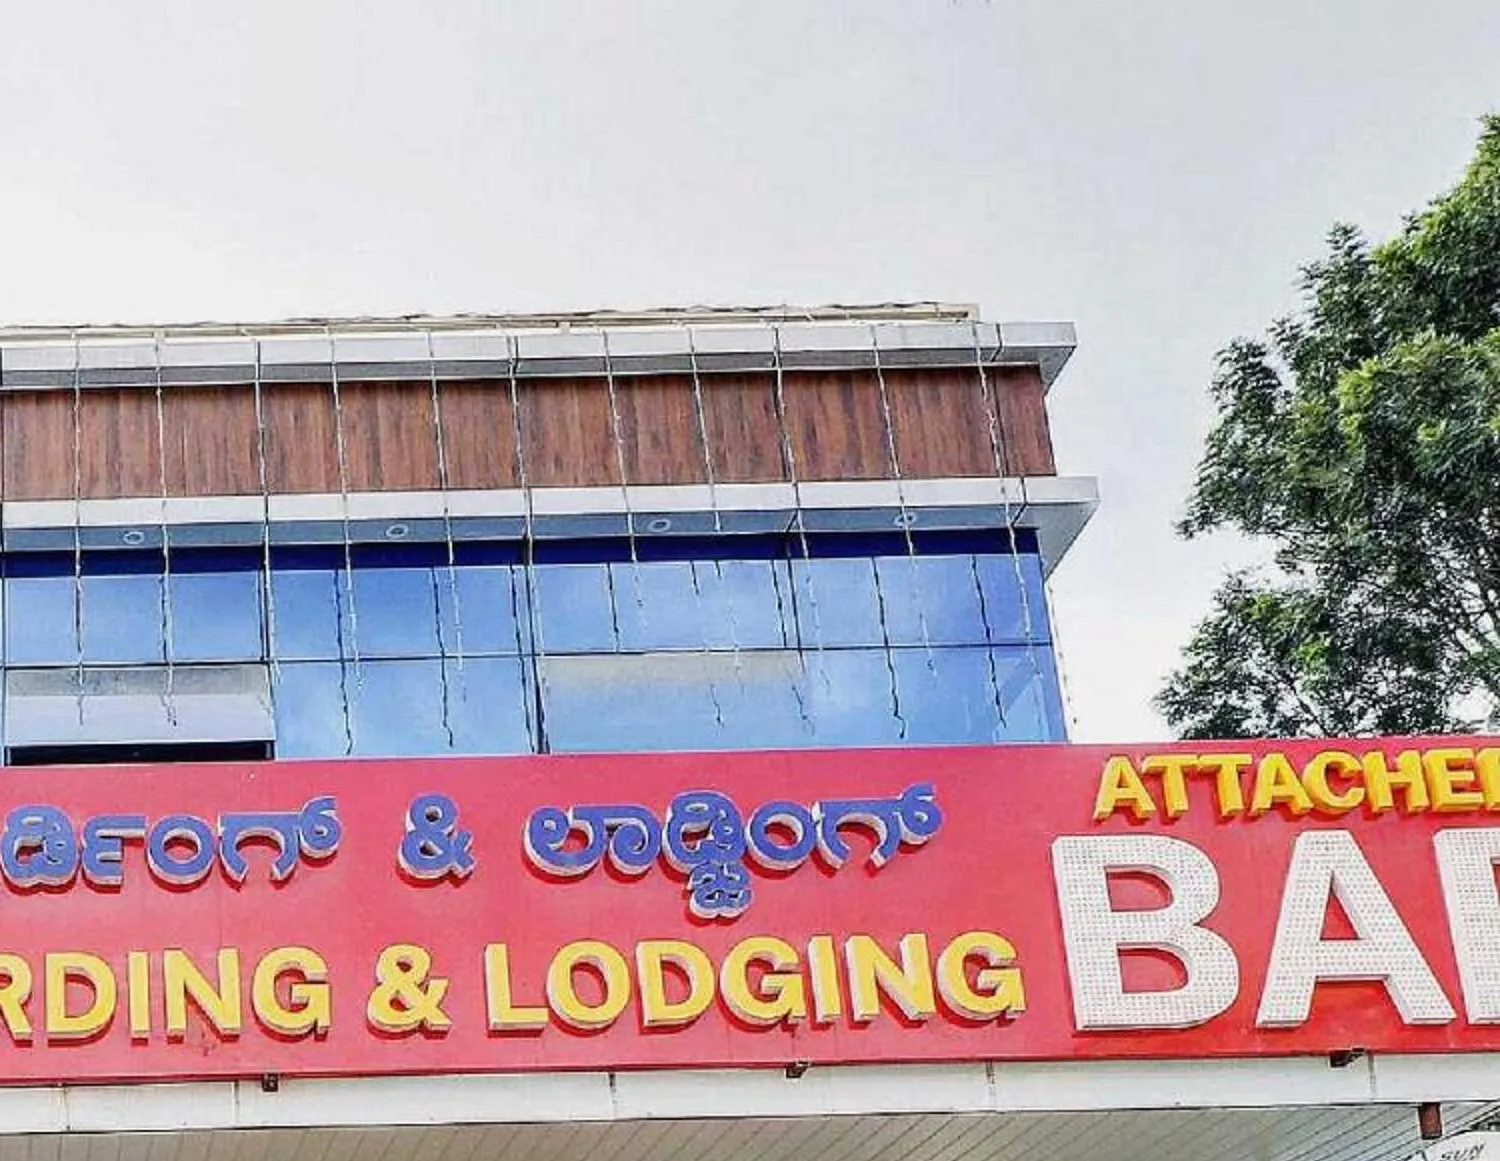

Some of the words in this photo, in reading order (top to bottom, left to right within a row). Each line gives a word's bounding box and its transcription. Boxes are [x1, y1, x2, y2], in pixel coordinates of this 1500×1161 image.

[399, 793, 476, 880] &
[366, 943, 450, 1042] &
[484, 931, 1026, 1034] LODGING
